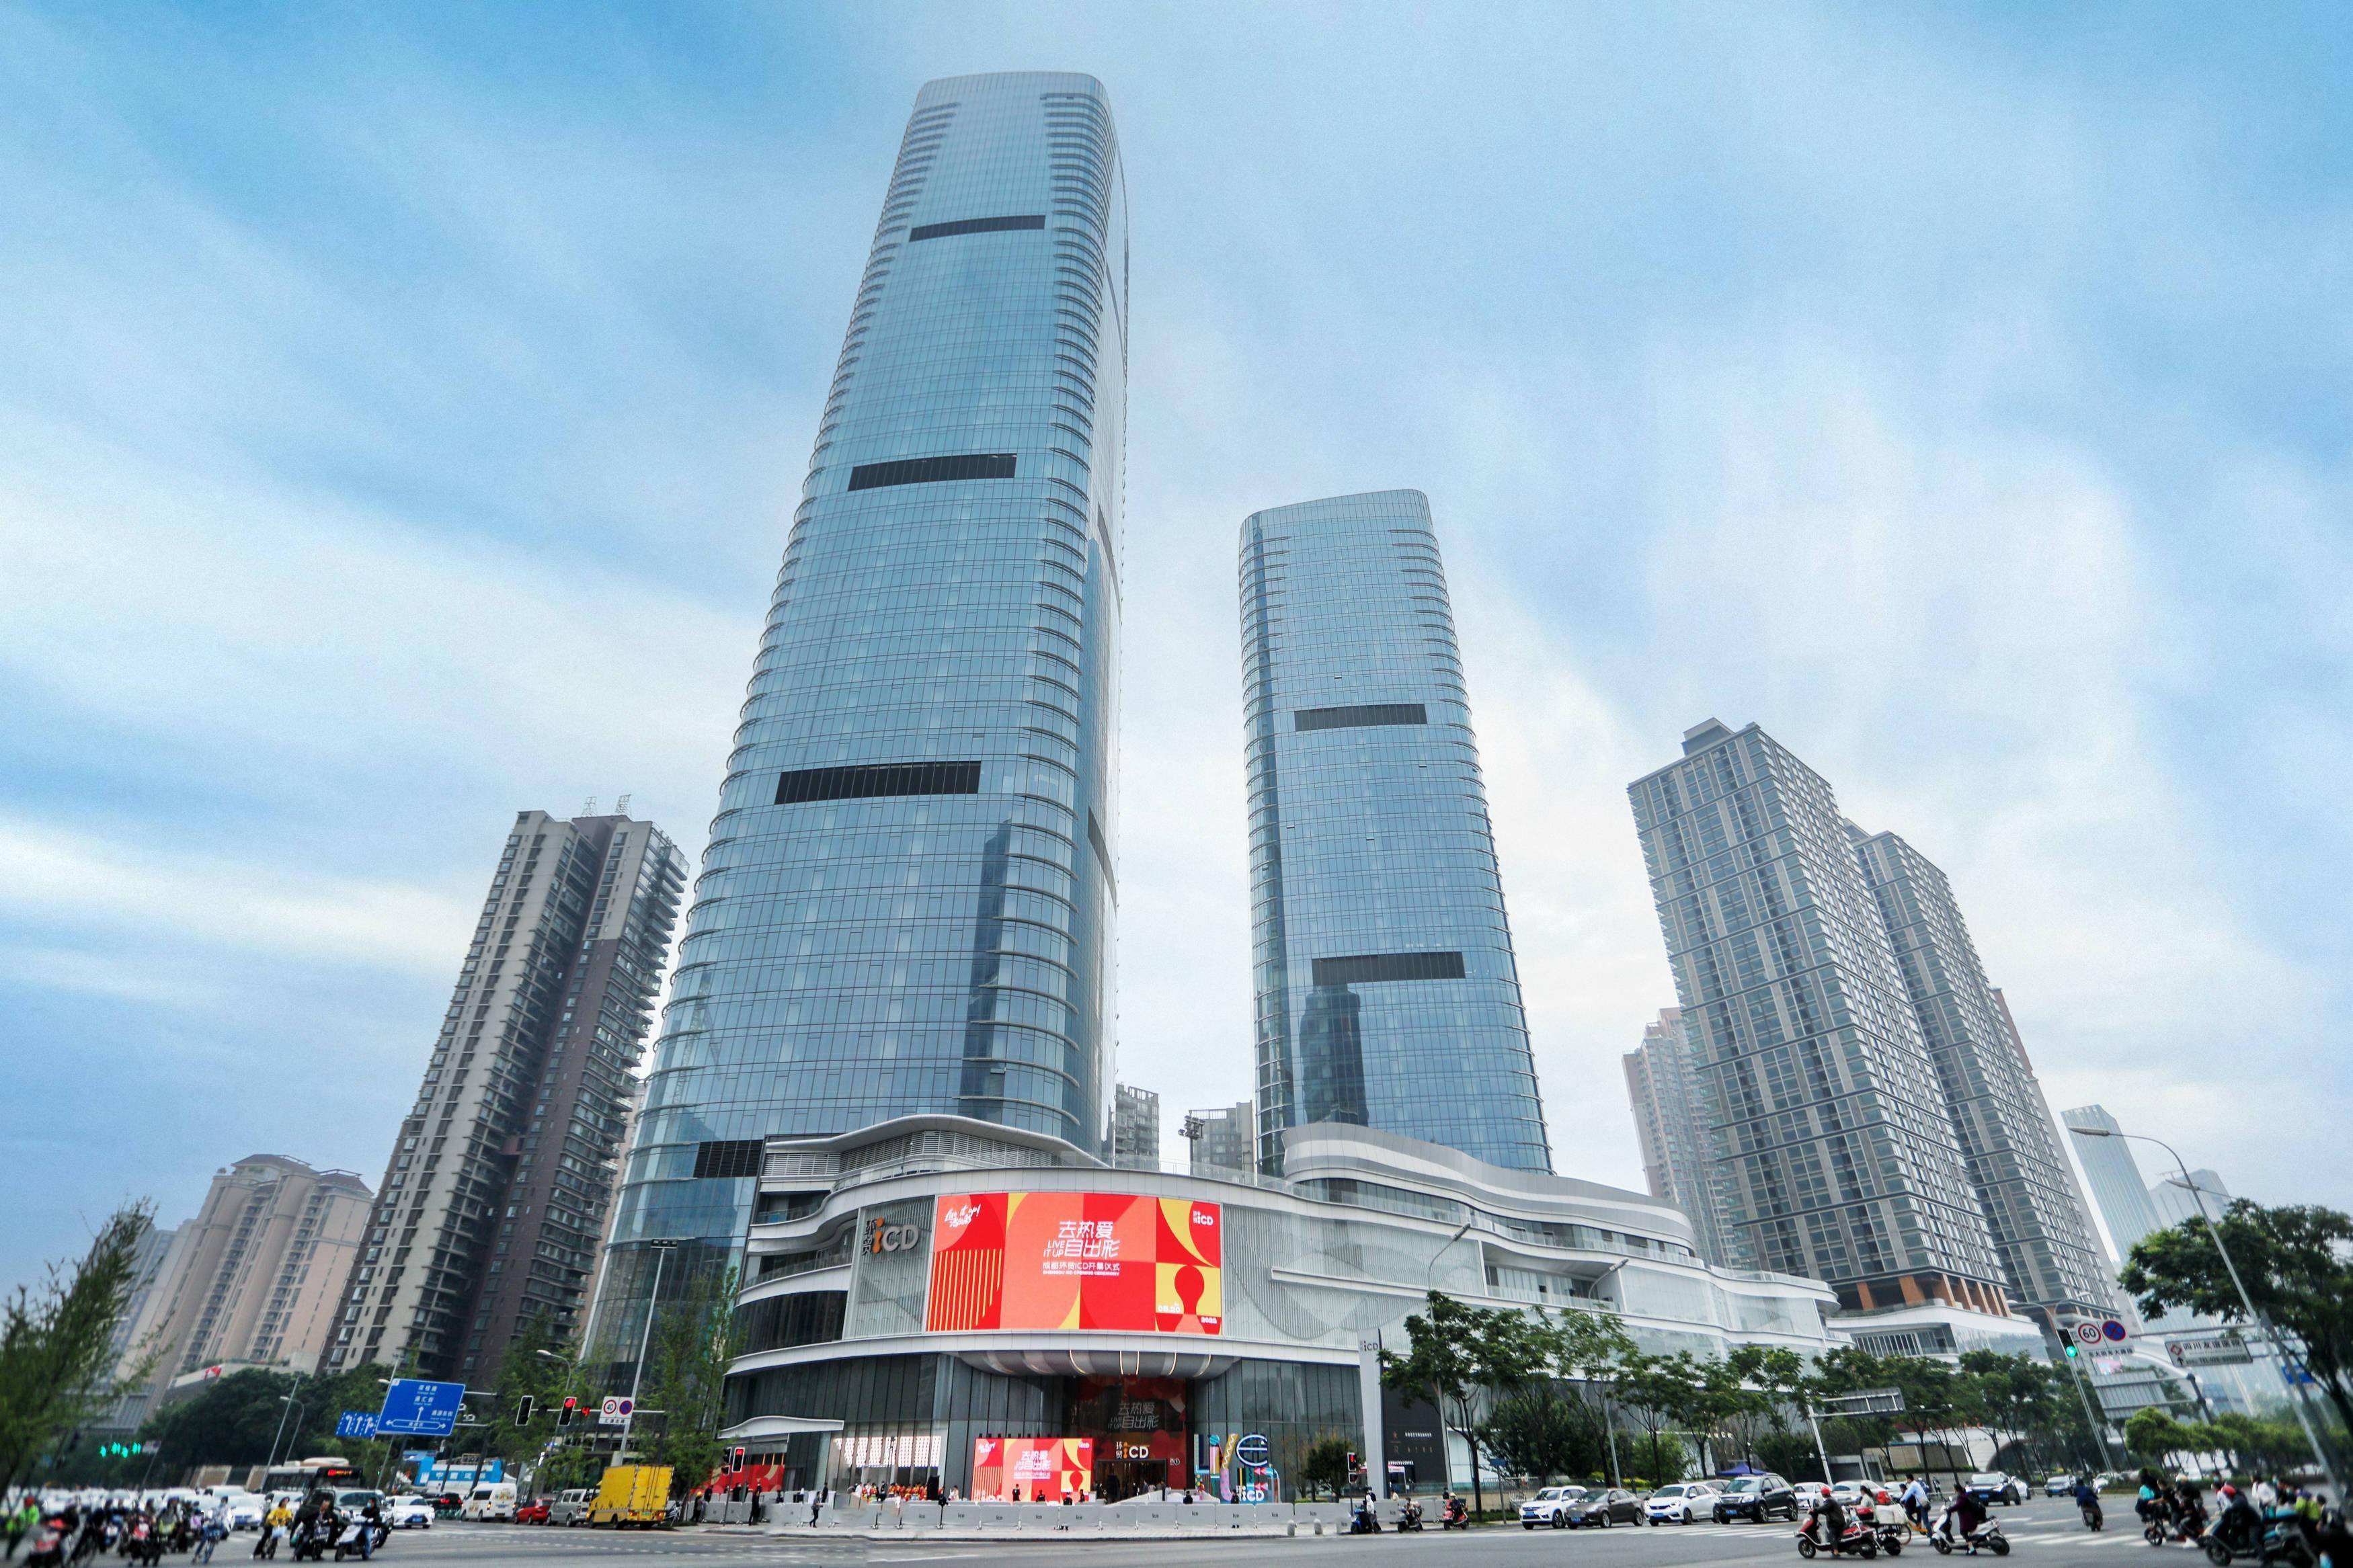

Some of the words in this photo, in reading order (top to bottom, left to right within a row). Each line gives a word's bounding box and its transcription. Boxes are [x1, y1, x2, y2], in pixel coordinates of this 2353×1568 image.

[1058, 1221, 1113, 1239] 去热爱
[1047, 1241, 1066, 1249] LIVE
[1064, 1239, 1120, 1260] 自出彩
[1052, 1249, 1064, 1257] UP
[2083, 1328, 2096, 1338] 60
